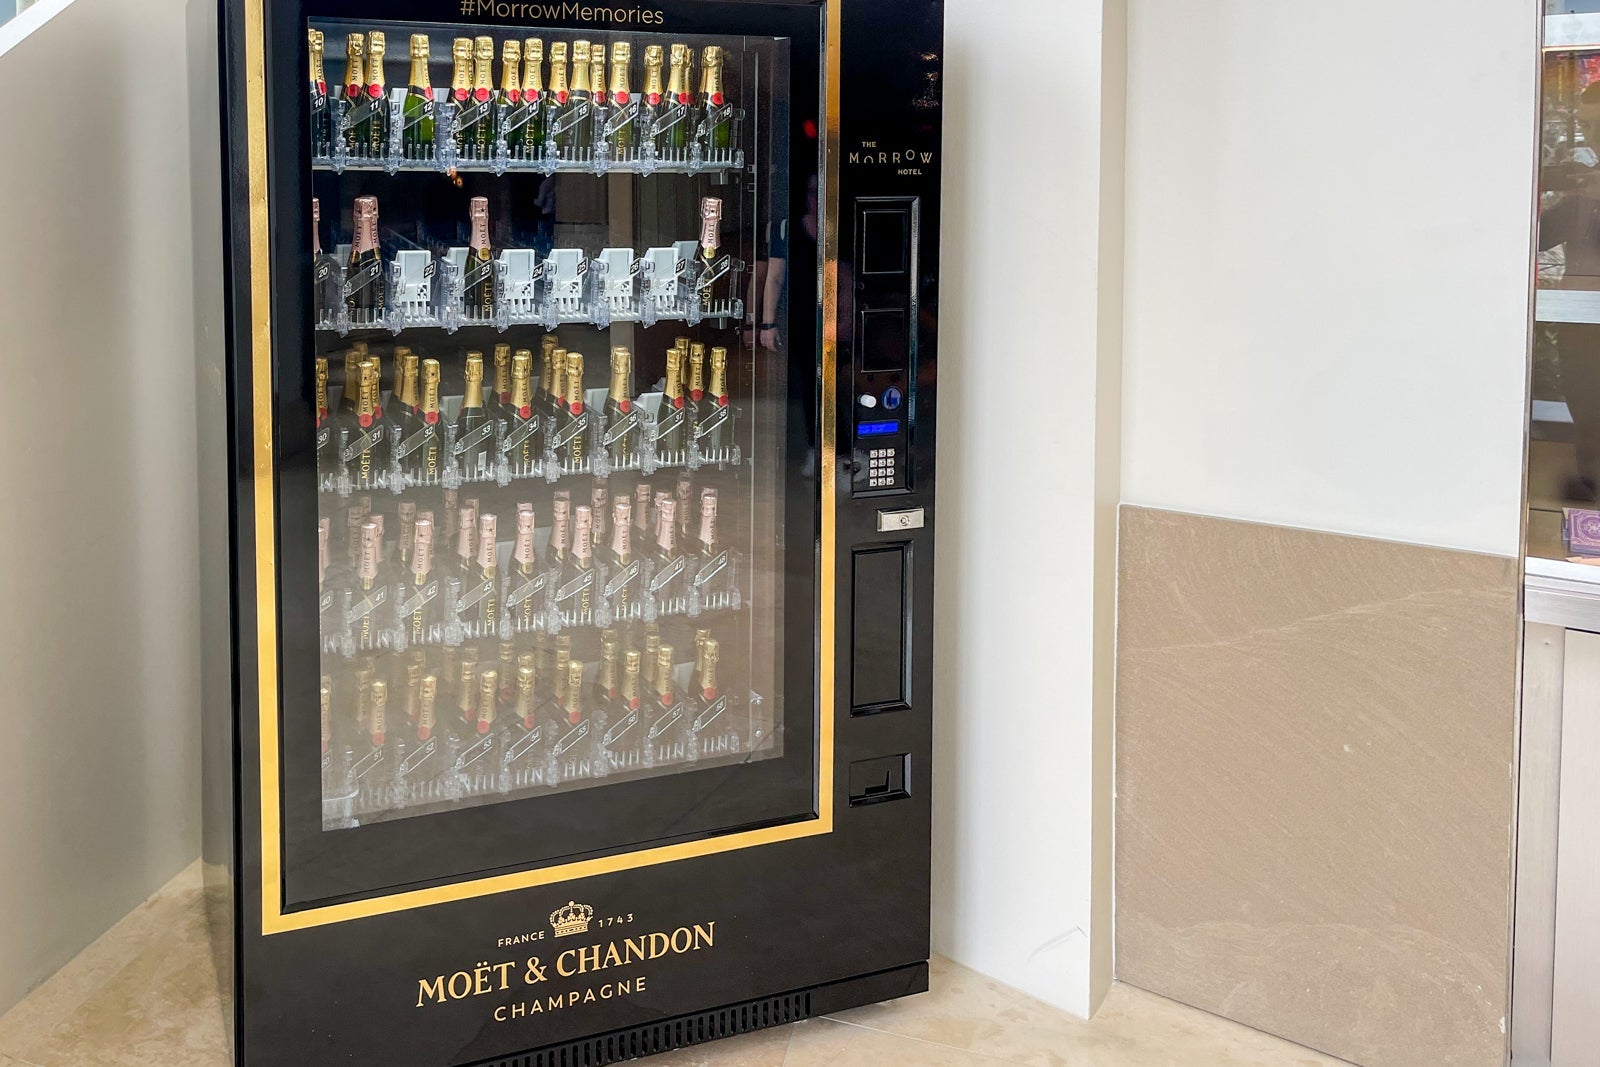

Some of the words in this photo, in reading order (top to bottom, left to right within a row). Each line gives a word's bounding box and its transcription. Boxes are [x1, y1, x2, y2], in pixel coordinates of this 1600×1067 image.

[460, 0, 664, 24] #MorrowMemories
[314, 97, 324, 108] 10
[369, 100, 379, 111] 11
[423, 101, 433, 113] 12
[479, 102, 488, 113] 13
[528, 102, 536, 113] 14
[578, 105, 587, 116] 15
[628, 104, 637, 115] 16
[676, 106, 685, 116] 17
[723, 107, 731, 117] 18
[481, 264, 490, 275] 23
[577, 262, 586, 273] 25
[630, 262, 638, 273] 26
[676, 260, 685, 272] 27
[720, 259, 728, 270] 28
[318, 267, 328, 278] 20
[370, 265, 379, 276] 21
[424, 265, 434, 276] 22
[533, 267, 543, 277] 24
[628, 413, 637, 425] 36
[675, 411, 683, 422] 37
[719, 409, 727, 420] 38
[528, 420, 537, 431] 34
[577, 417, 586, 428] 35
[424, 426, 433, 437] 32
[481, 425, 491, 435] 33
[318, 433, 327, 444] 30
[372, 431, 380, 441] 31
[498, 930, 545, 947] FRANCE
[599, 913, 634, 928] 1743
[415, 961, 515, 1007] MOËT
[524, 956, 548, 985] &
[556, 921, 716, 977] CHANDON
[494, 976, 646, 1022] CHAMPAGNE
